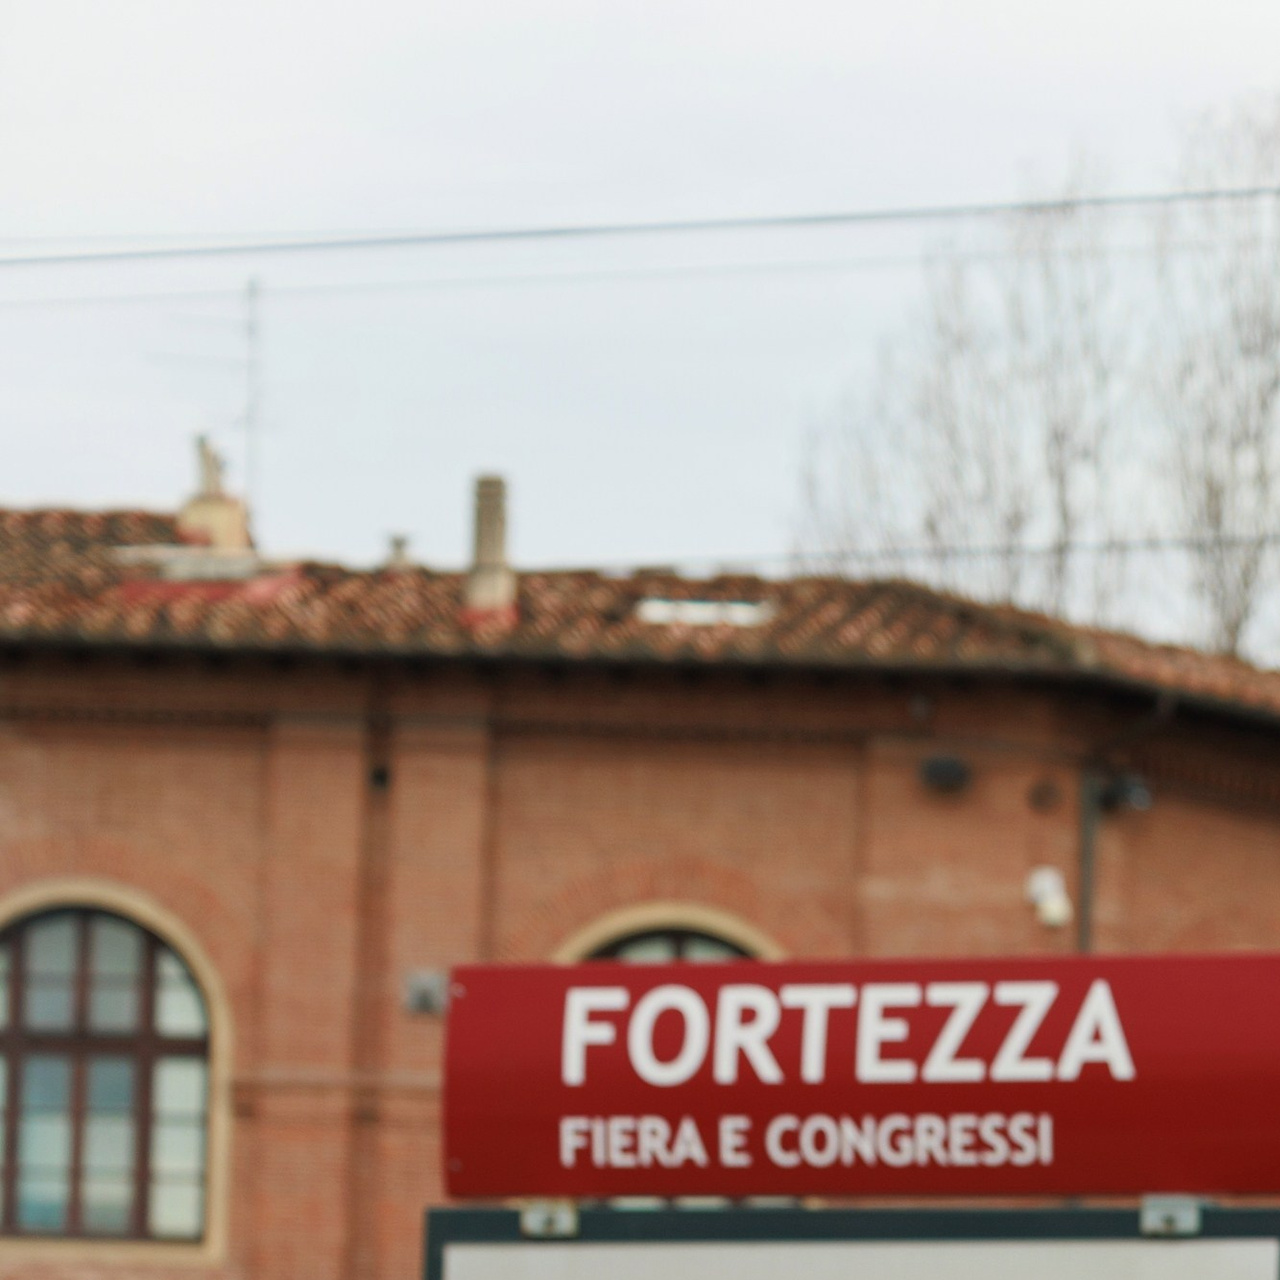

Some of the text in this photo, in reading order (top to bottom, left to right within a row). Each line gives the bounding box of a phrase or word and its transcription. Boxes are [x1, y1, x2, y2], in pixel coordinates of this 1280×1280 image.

[561, 978, 1136, 1087] FORTEZZA
[558, 1113, 1054, 1168] FIERA E CONGRESSI
